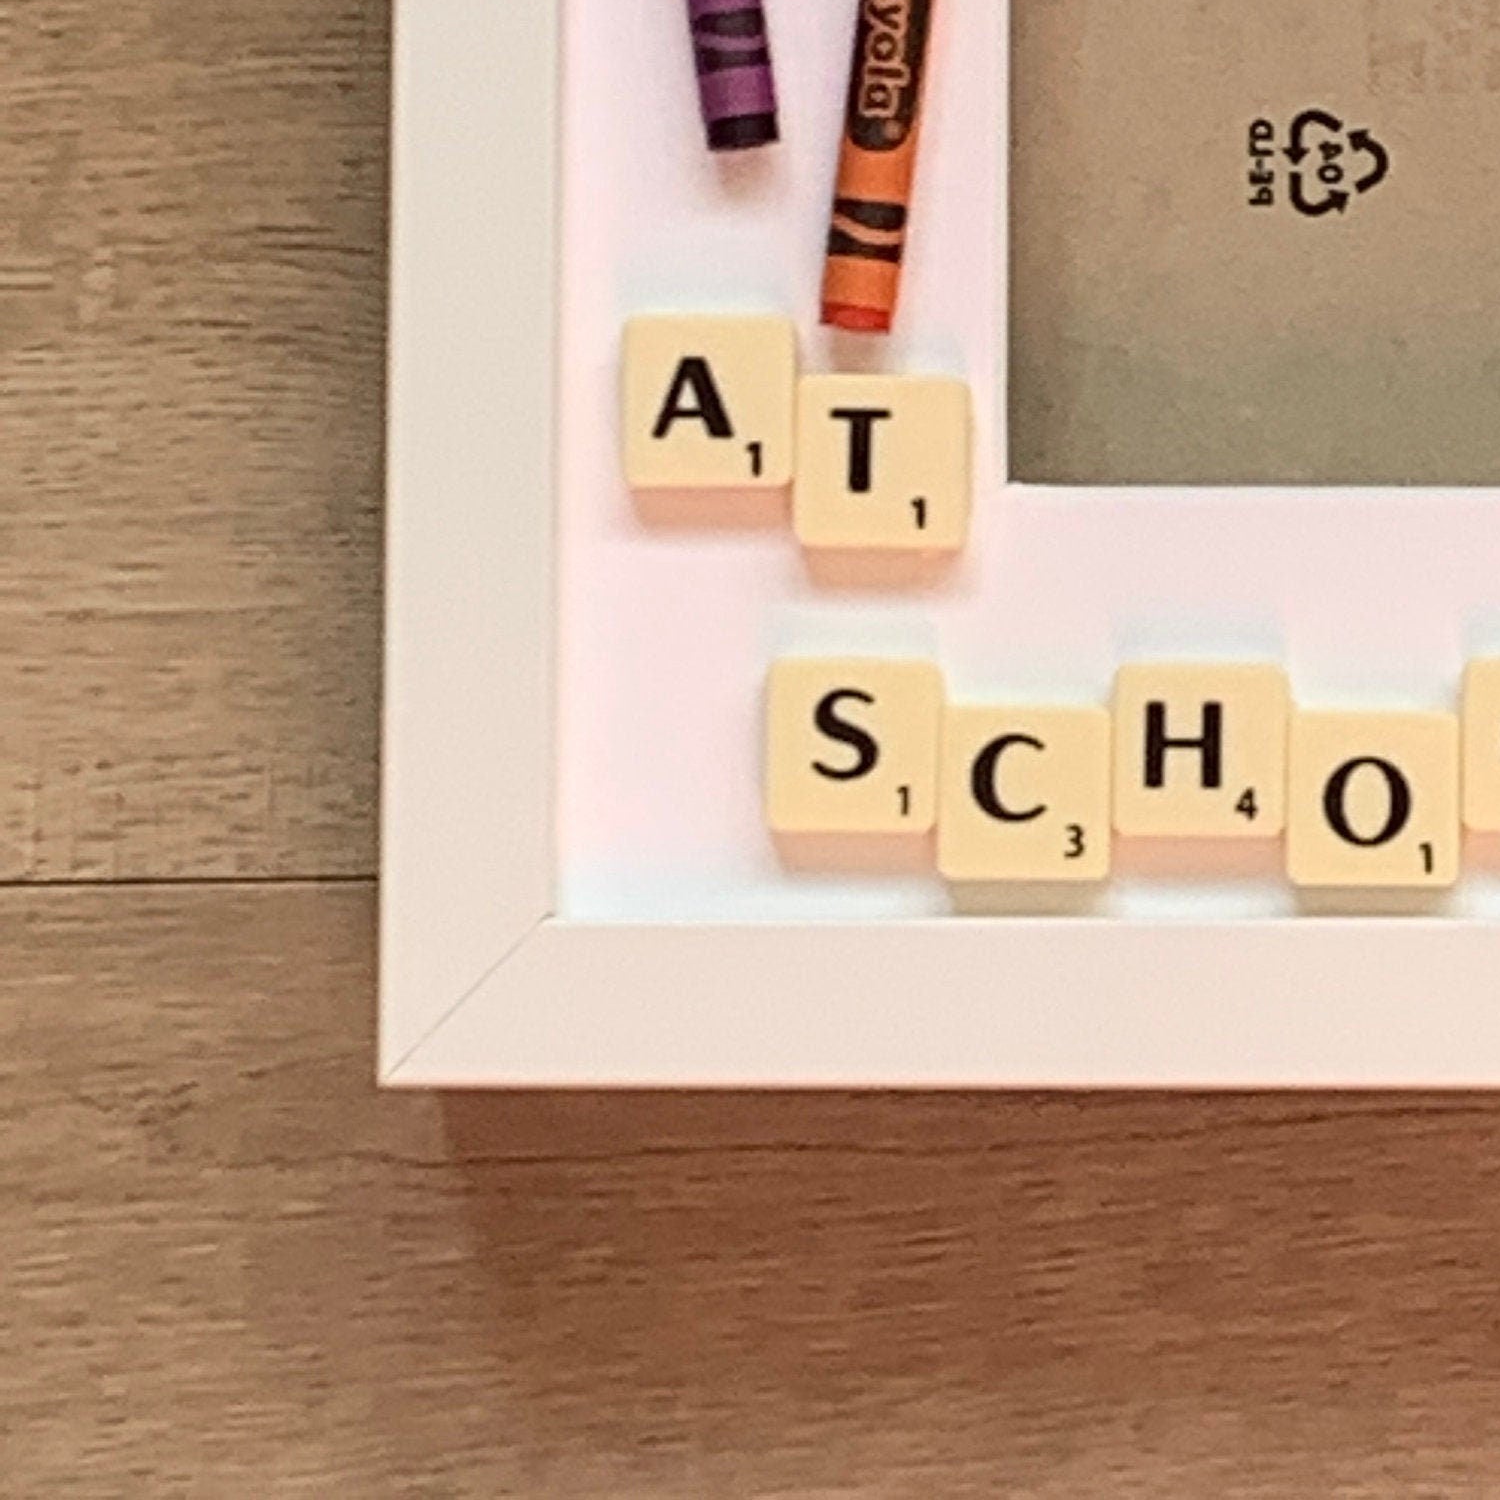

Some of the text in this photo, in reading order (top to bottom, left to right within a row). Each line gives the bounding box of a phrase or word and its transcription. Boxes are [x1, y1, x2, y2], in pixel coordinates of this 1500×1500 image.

[745, 440, 928, 531] 1 1
[896, 783, 911, 817] 1
[1064, 823, 1085, 859] 3
[1234, 787, 1259, 821] 4
[1419, 841, 1434, 875] 1
